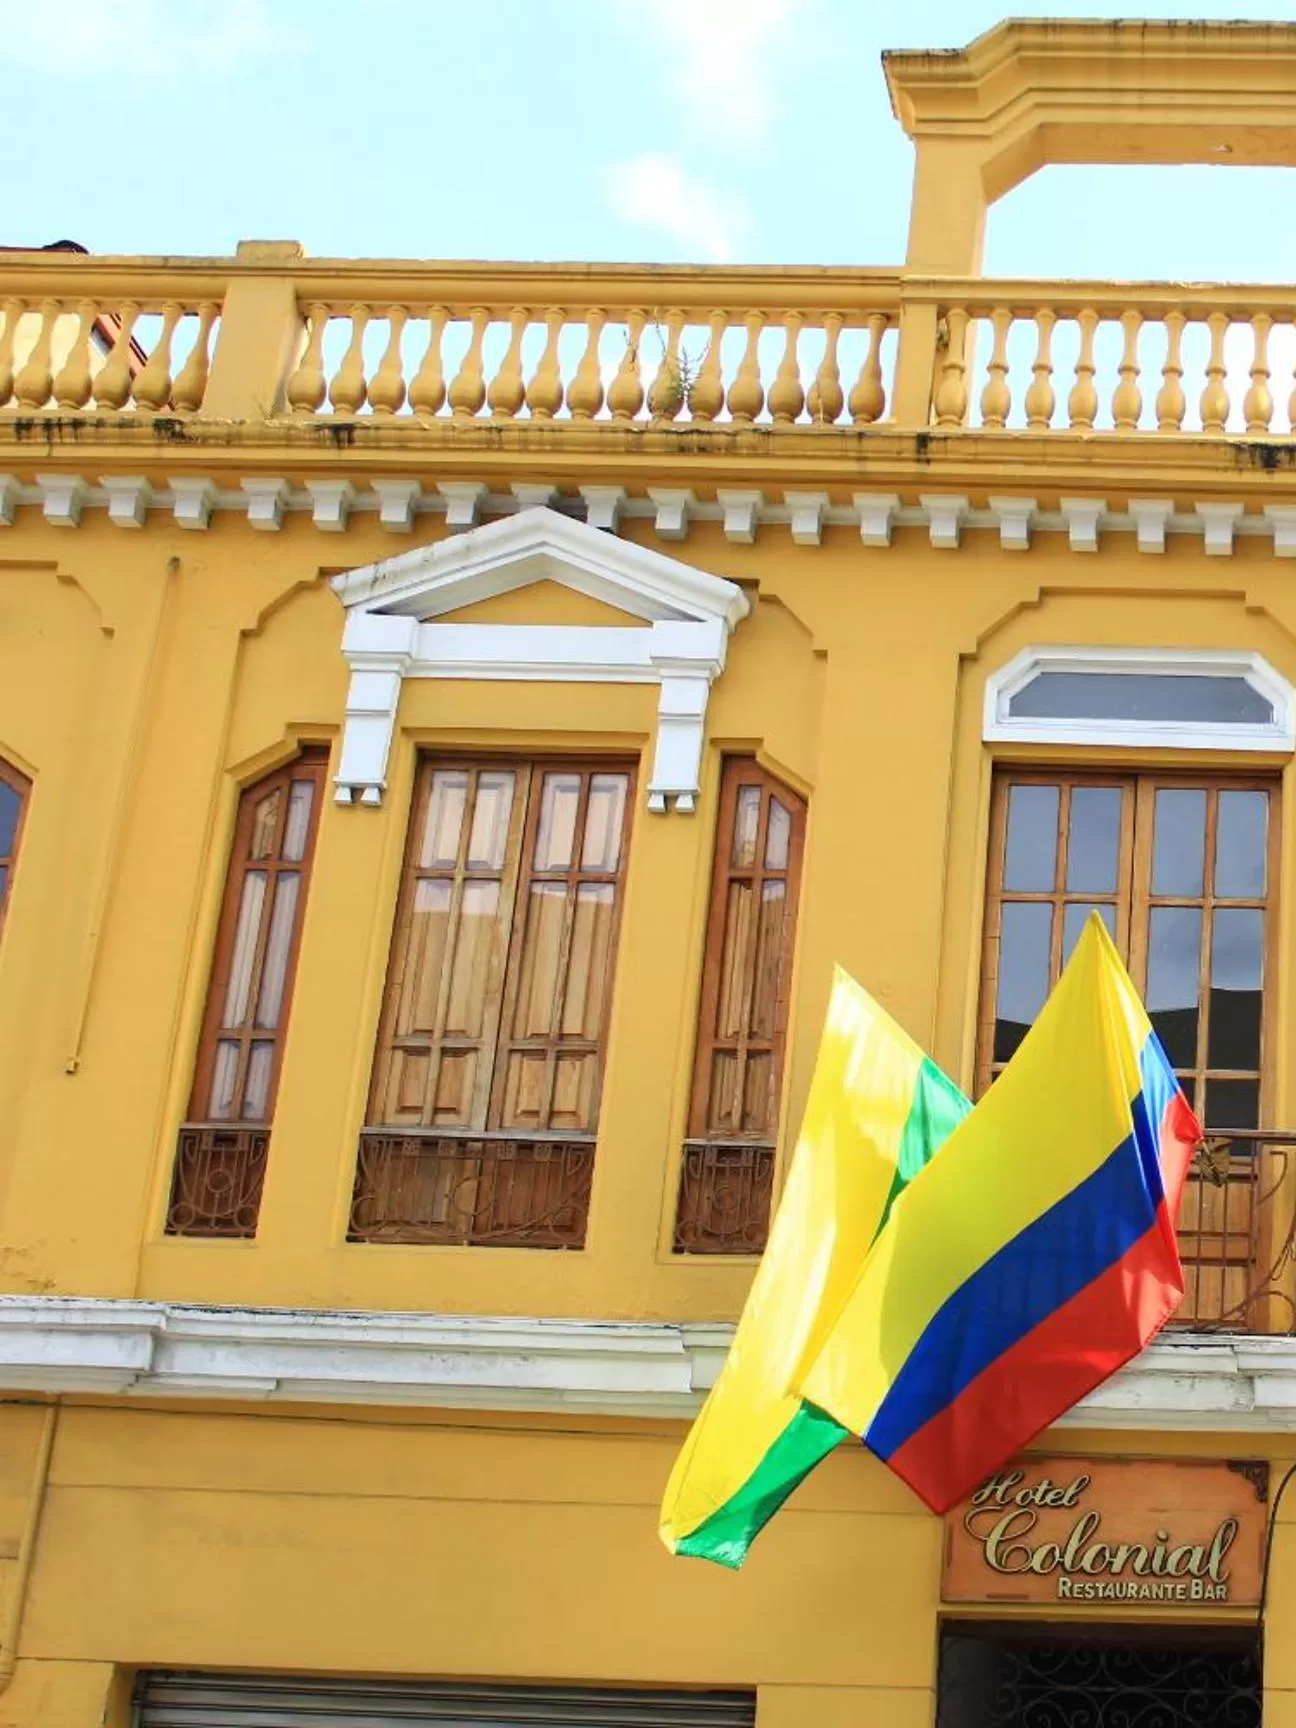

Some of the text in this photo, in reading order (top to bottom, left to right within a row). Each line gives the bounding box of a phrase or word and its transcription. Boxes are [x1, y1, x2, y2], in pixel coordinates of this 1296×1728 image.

[971, 1470, 1091, 1507] Hotel
[964, 1507, 1238, 1583] Colonial
[1058, 1576, 1229, 1601] RESTAURANTE BAR
